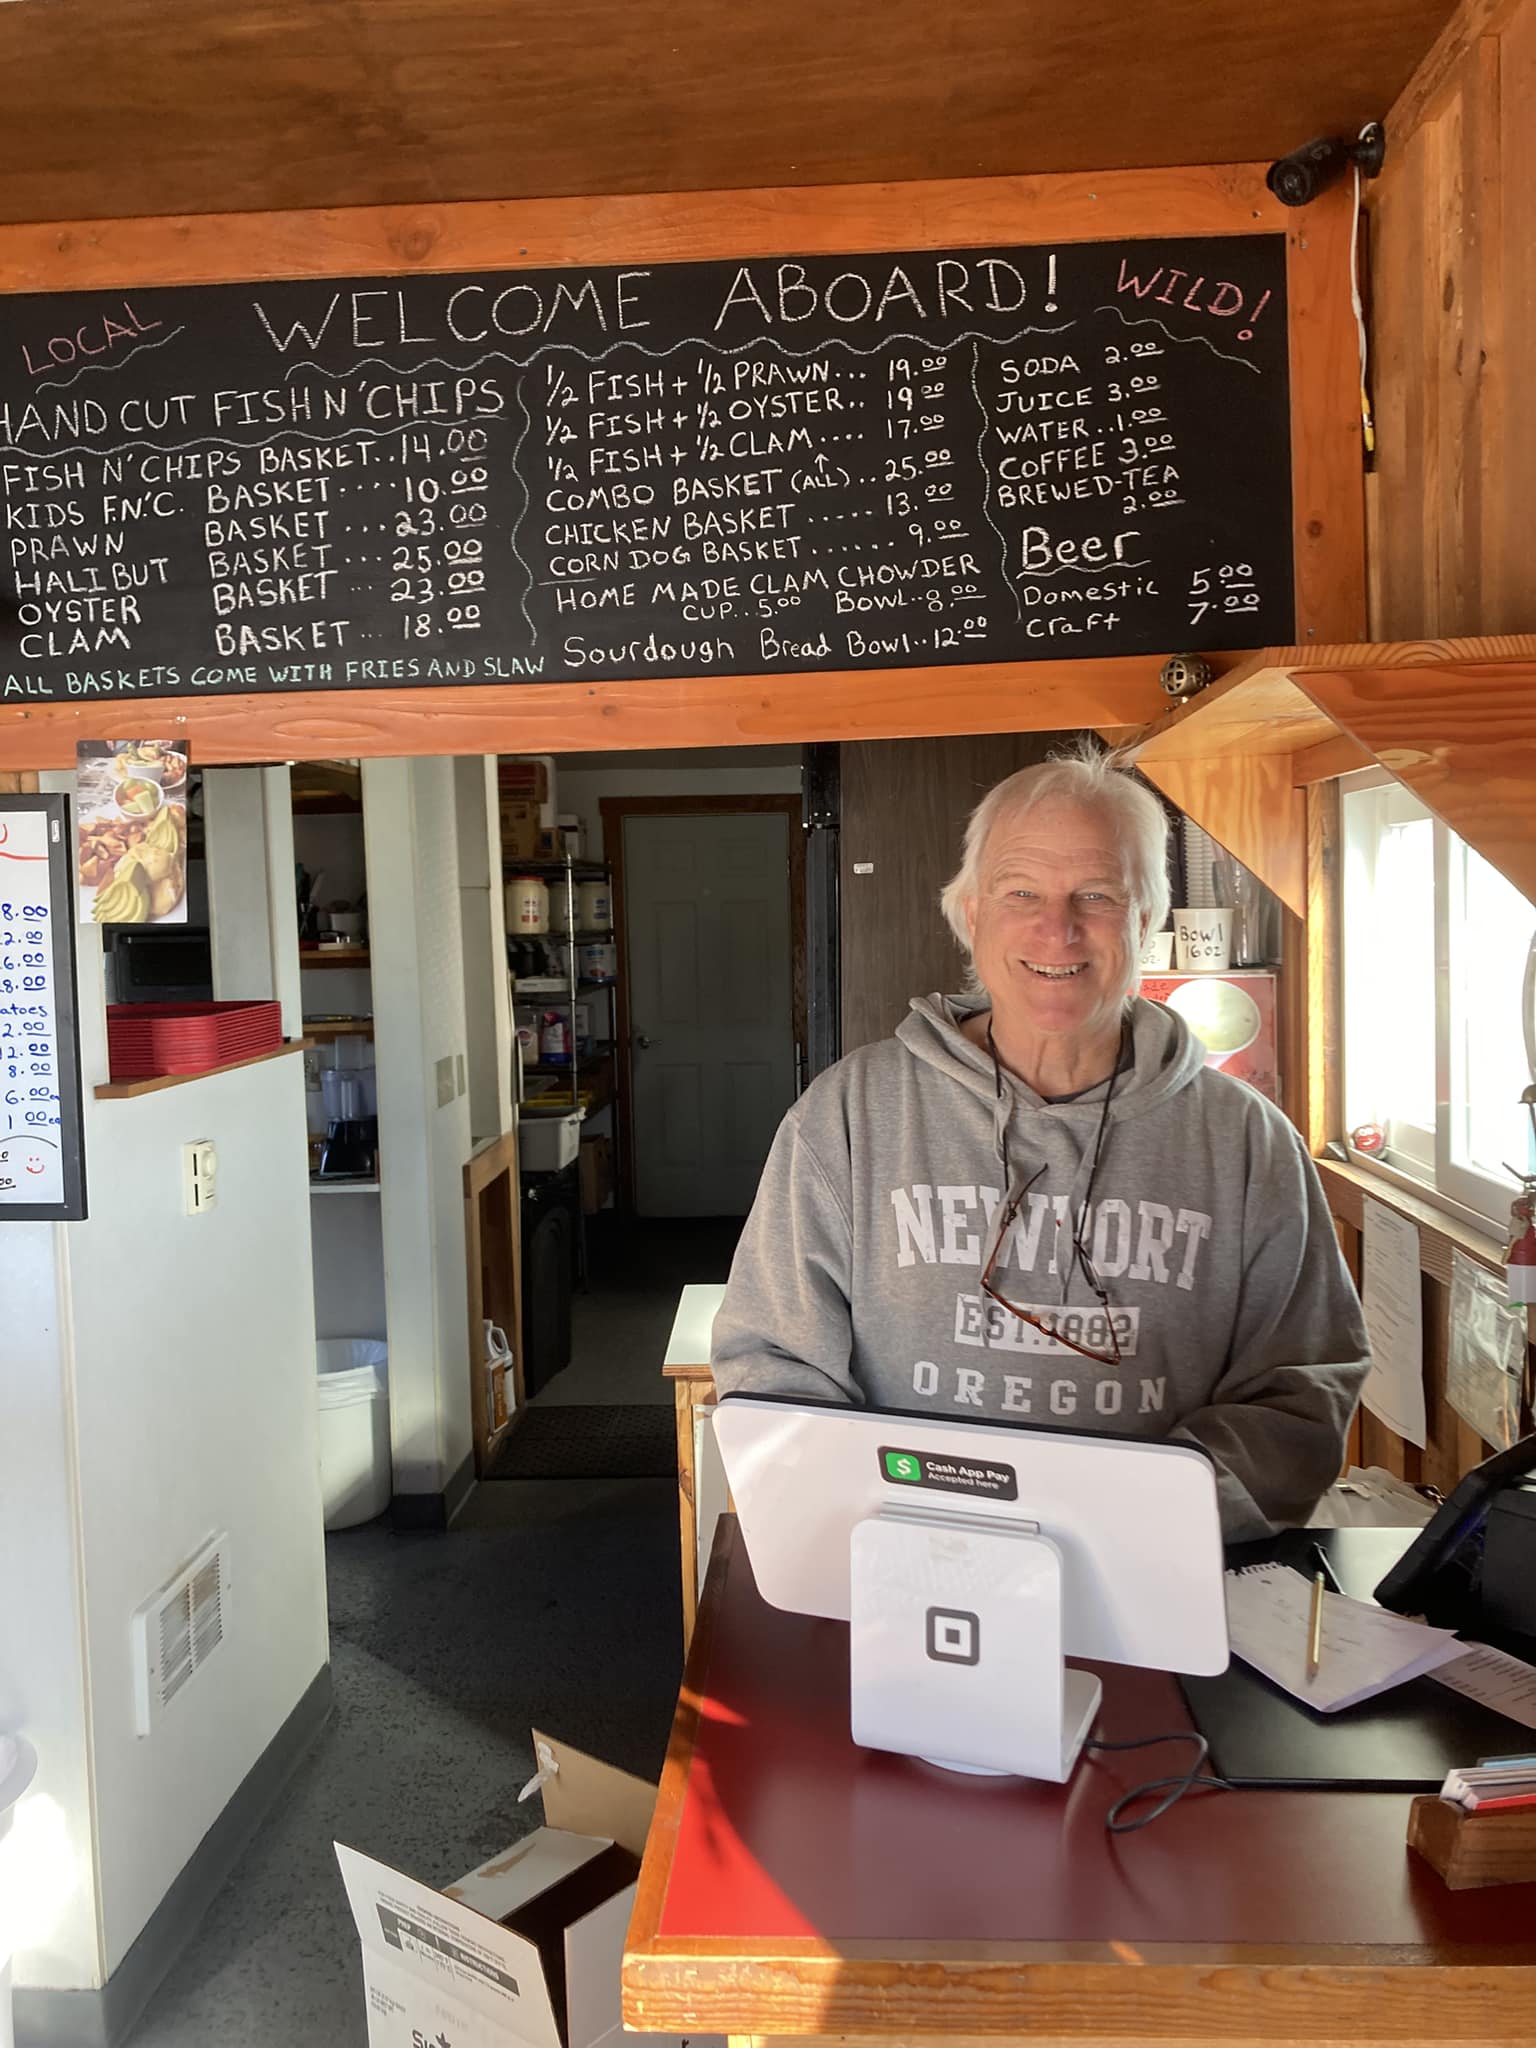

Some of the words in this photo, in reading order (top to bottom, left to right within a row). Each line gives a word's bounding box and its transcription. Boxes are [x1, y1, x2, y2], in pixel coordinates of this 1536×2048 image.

[252, 271, 652, 352] WELCOME
[713, 253, 1059, 332] ABOARD!
[1116, 258, 1272, 341] WILD!
[21, 301, 163, 376] LOCAL
[1000, 354, 1081, 384] SODA
[1104, 342, 1165, 365] 2.00
[588, 369, 665, 405] FISH
[734, 359, 830, 391] PRAWN
[995, 386, 1094, 414] JUICE
[1107, 375, 1161, 403] 3.00
[119, 394, 197, 433] CUT
[213, 386, 312, 428] FISH
[588, 407, 666, 440] FISH
[728, 387, 845, 421] OYSTER
[995, 417, 1090, 445] WATER
[2, 461, 86, 496] FISH
[401, 428, 488, 465] 14.00
[589, 443, 663, 477] FISH
[729, 426, 814, 458] CLAM
[887, 413, 945, 440] 17.00
[998, 441, 1106, 480] COFFEE
[1117, 433, 1177, 465] 3.00
[6, 500, 85, 530] KIDS
[207, 476, 330, 515] BASKET
[405, 466, 489, 504] 10.00
[546, 483, 655, 513] COMBO
[673, 468, 783, 507] BASKET
[884, 448, 955, 483] 25.00
[1122, 488, 1186, 515] 2.00
[10, 531, 125, 568] PRAWN
[204, 510, 330, 549] BASKET
[544, 515, 672, 546] CHICKEN
[683, 503, 797, 542] BASKET
[886, 482, 955, 517] 13.00
[14, 557, 169, 600] HALIBUT
[207, 542, 333, 580] BASKET
[392, 538, 484, 574] 25.00
[549, 550, 619, 577] CORN
[627, 545, 692, 570] DOG
[702, 535, 802, 564] BASKET
[908, 519, 970, 548] 9.00
[1021, 526, 1142, 570] Beer
[17, 594, 142, 626] OYSTER
[211, 569, 339, 617] BASKET
[389, 569, 487, 605] 23.00
[556, 582, 635, 614] HOME
[651, 576, 742, 605] MADE
[749, 568, 830, 595] CLAM
[837, 553, 982, 588] CHOWDER
[1023, 576, 1160, 607] Domestic
[1187, 592, 1261, 626] 7.00
[19, 626, 132, 659] CLAM
[214, 620, 351, 657] BASKET
[404, 604, 482, 640] 18.00
[682, 601, 733, 622] CUP
[563, 632, 735, 668] Sourdough
[760, 626, 833, 661] Bread
[3, 674, 54, 697] ALL
[65, 665, 181, 694] BASKETS
[190, 666, 257, 686] COME
[268, 663, 333, 683] WITH
[345, 657, 420, 682] FRIES
[427, 658, 476, 679] AND
[483, 655, 545, 678] SLAW
[1181, 924, 1223, 942] Bowl
[912, 1361, 1167, 1416] OREGON
[926, 1461, 956, 1475] Cash
[959, 1466, 985, 1480] App
[987, 1470, 1010, 1484] Pay
